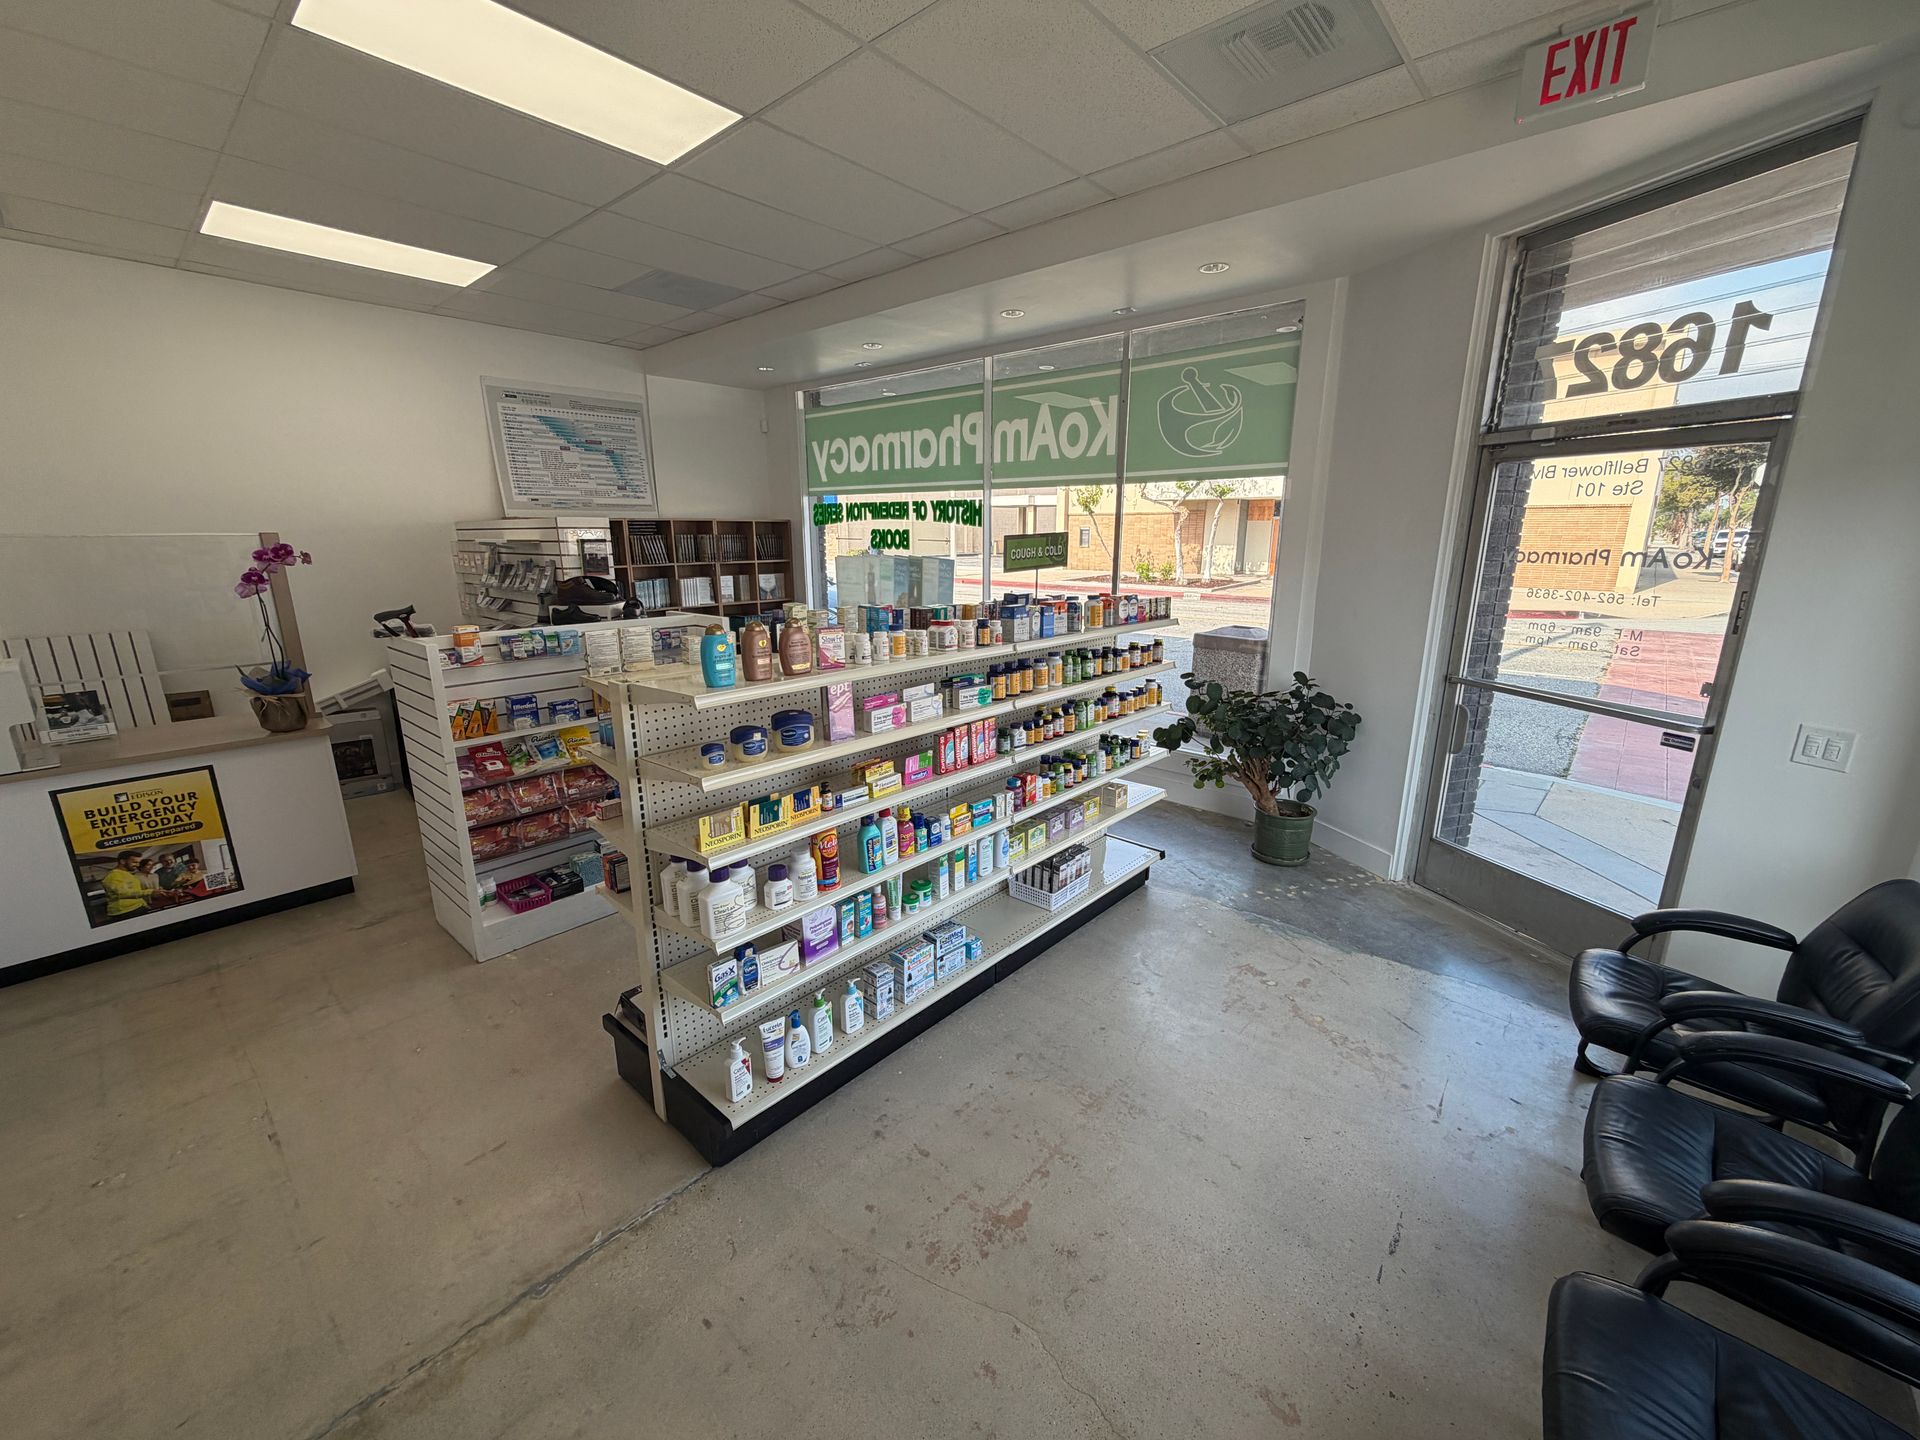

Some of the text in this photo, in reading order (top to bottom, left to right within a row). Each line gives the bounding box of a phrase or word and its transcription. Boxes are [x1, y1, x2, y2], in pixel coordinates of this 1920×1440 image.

[1540, 16, 1638, 106] EXIT
[1010, 544, 1064, 560] COUGH & COLD
[84, 791, 199, 820] BUILD YOUR
[90, 801, 198, 829] EMERGENCY
[99, 812, 195, 839] KIT TODAY
[103, 823, 197, 847] sce.com/beprepared
[705, 832, 742, 848] NEOSPORIN
